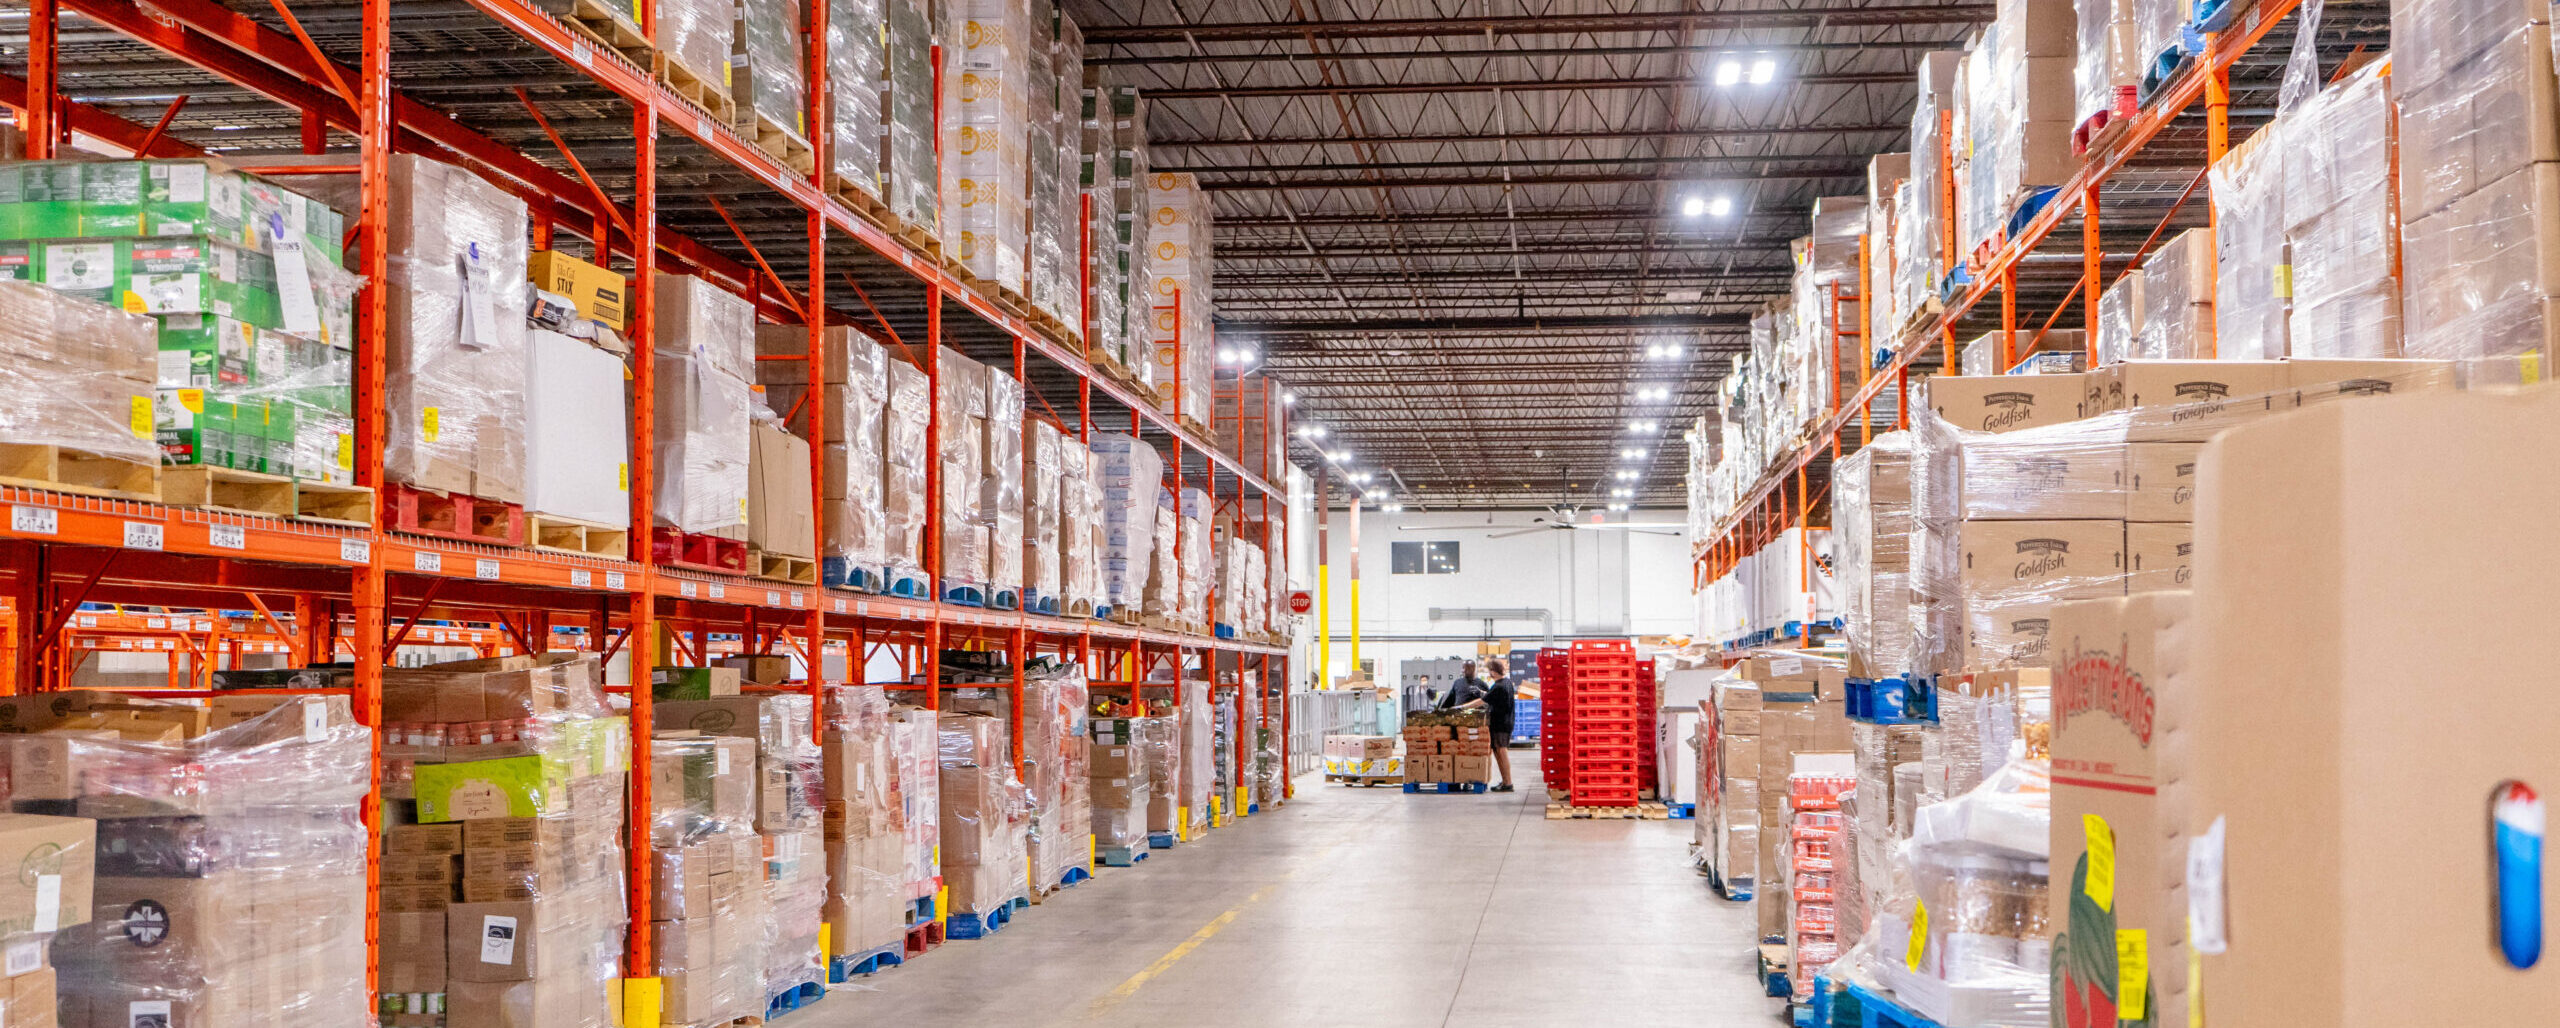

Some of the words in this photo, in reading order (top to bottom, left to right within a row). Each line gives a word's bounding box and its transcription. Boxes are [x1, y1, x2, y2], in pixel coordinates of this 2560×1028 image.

[557, 277, 574, 296] STIX
[1983, 405, 2032, 431] Goldfish
[16, 516, 45, 530] C-17-A
[2014, 553, 2065, 579] Goldfish
[1291, 598, 1310, 607] STOP
[2010, 634, 2050, 660] Goldfi
[1800, 797, 1824, 807] poppi
